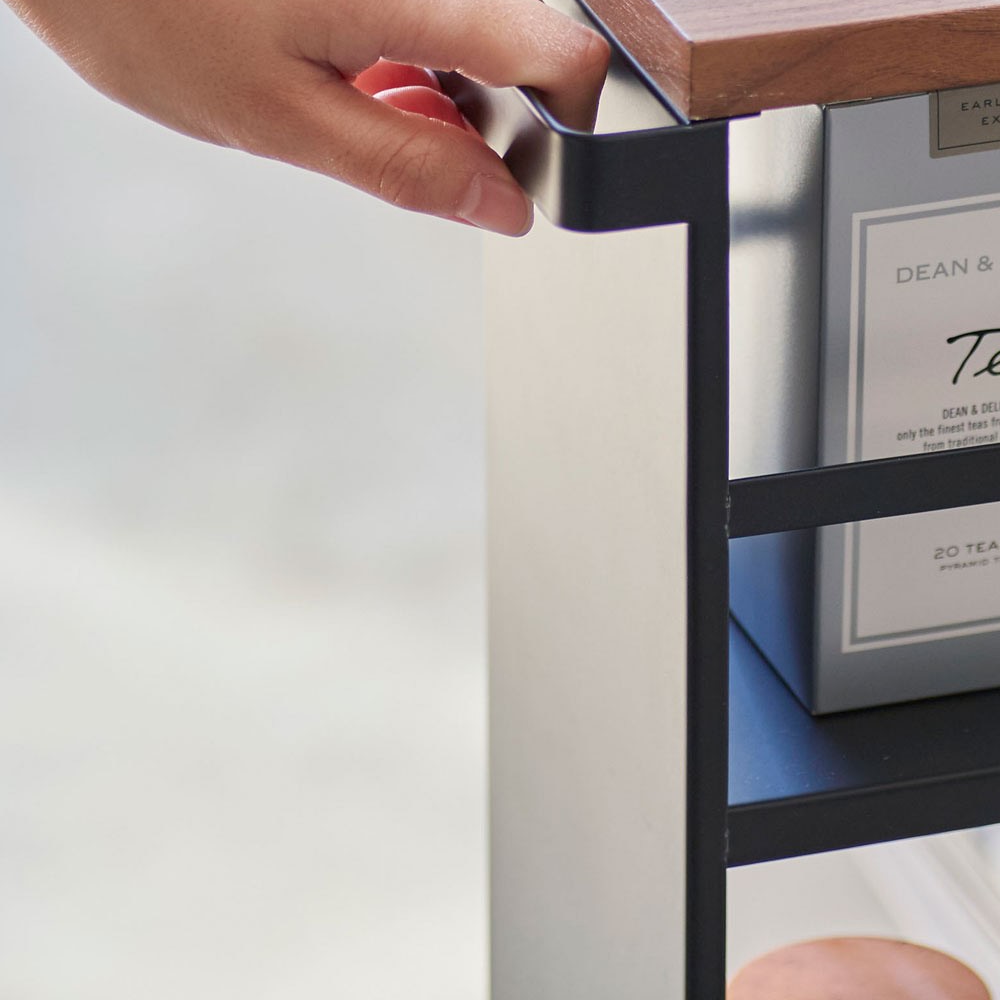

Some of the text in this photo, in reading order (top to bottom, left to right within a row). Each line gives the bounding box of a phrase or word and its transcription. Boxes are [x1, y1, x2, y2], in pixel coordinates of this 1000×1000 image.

[896, 258, 969, 284] DEAN
[977, 255, 993, 272] &
[943, 406, 968, 420] DEAN
[971, 404, 978, 416] &
[897, 428, 917, 442] only
[919, 424, 935, 438] the
[937, 421, 965, 435] finest
[968, 418, 988, 432] teas
[923, 441, 946, 454] from
[948, 433, 998, 449] traditional
[933, 546, 960, 560] 20
[966, 541, 1000, 555] TEA
[940, 559, 988, 571] PYRAMID
